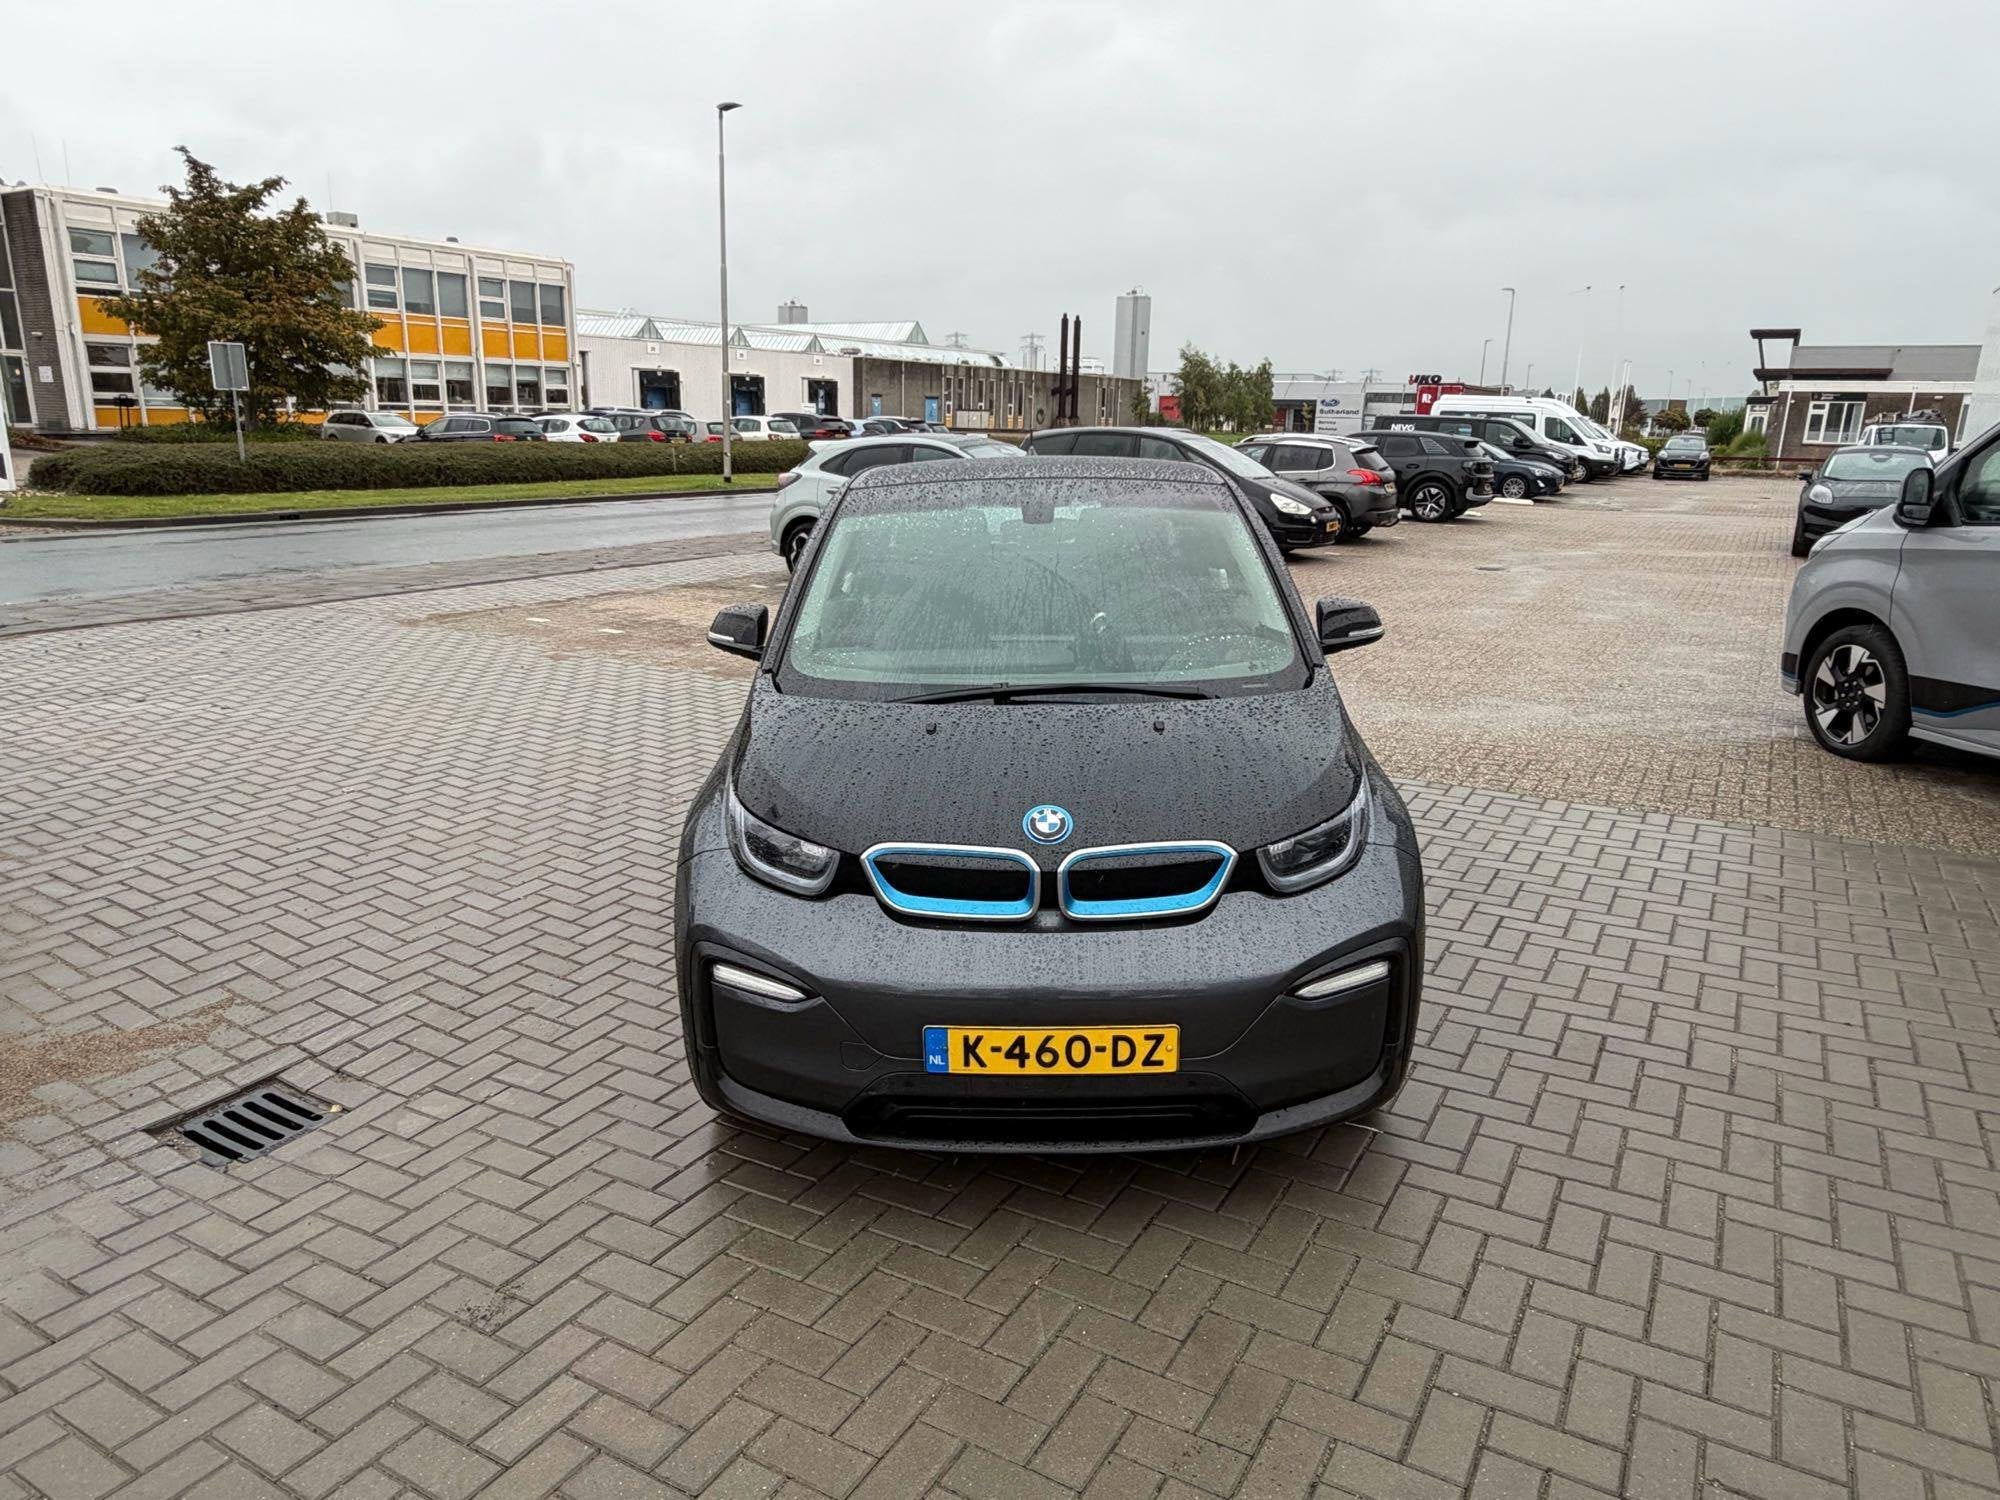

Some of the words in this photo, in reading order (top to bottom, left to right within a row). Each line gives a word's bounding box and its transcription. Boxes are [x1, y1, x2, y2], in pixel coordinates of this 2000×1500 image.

[1391, 423, 1415, 432] NIVO
[962, 1033, 1166, 1069] K-460-DZ
[929, 1054, 945, 1066] NL
